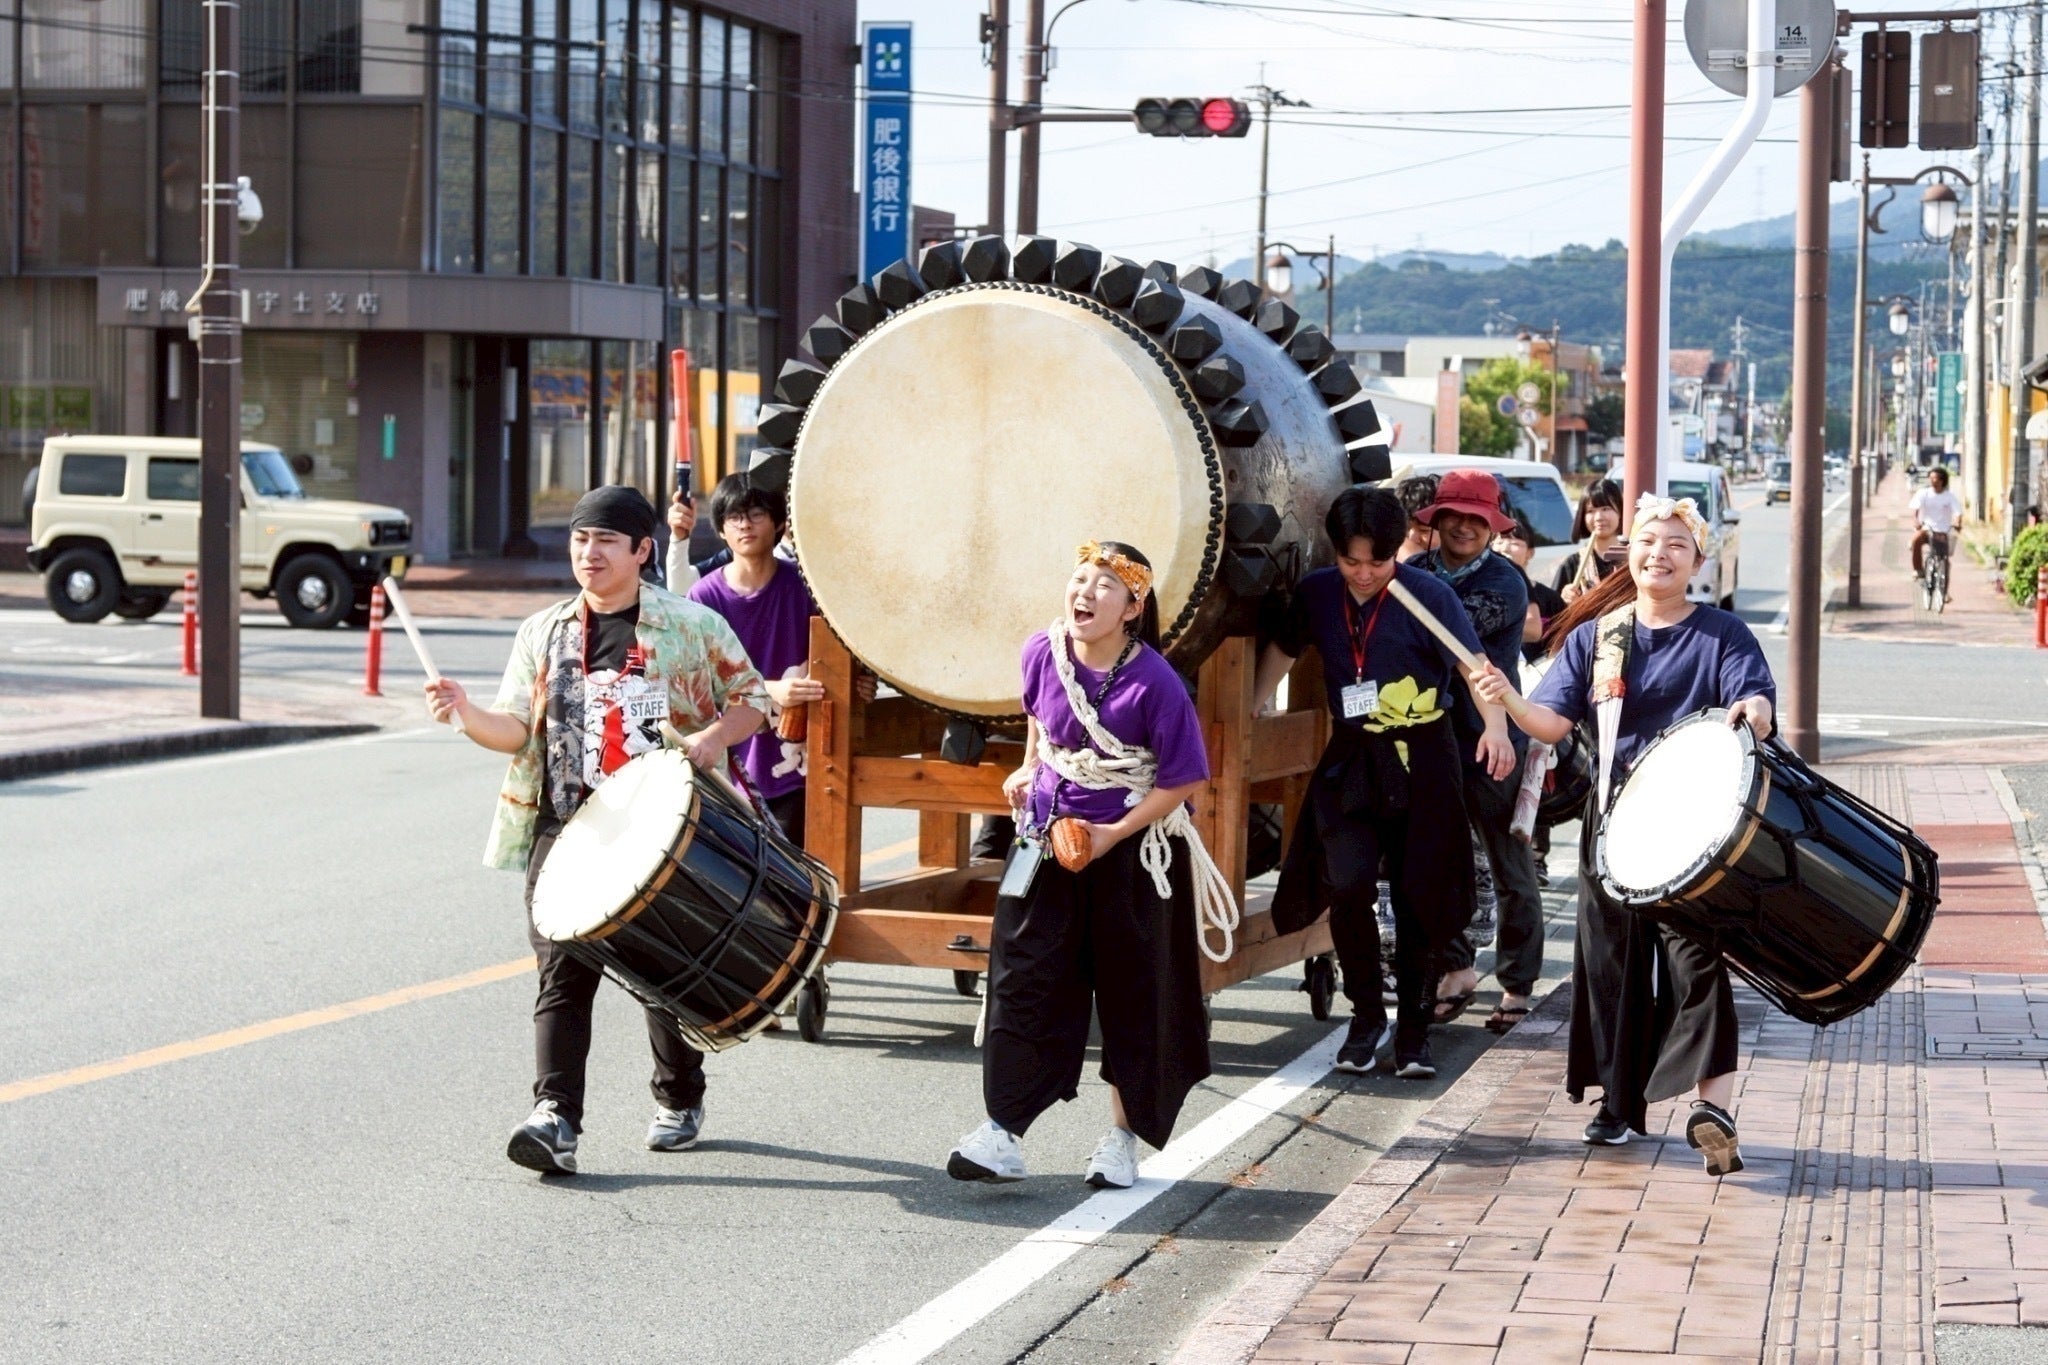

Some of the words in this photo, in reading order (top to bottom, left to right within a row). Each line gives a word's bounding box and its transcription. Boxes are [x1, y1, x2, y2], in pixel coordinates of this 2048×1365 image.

[1784, 26, 1802, 37] 14
[872, 117, 901, 232] 肥後銀行
[125, 288, 381, 315] 肥後宇土支店
[630, 700, 664, 717] STAFF
[1347, 699, 1375, 715] STAFF
